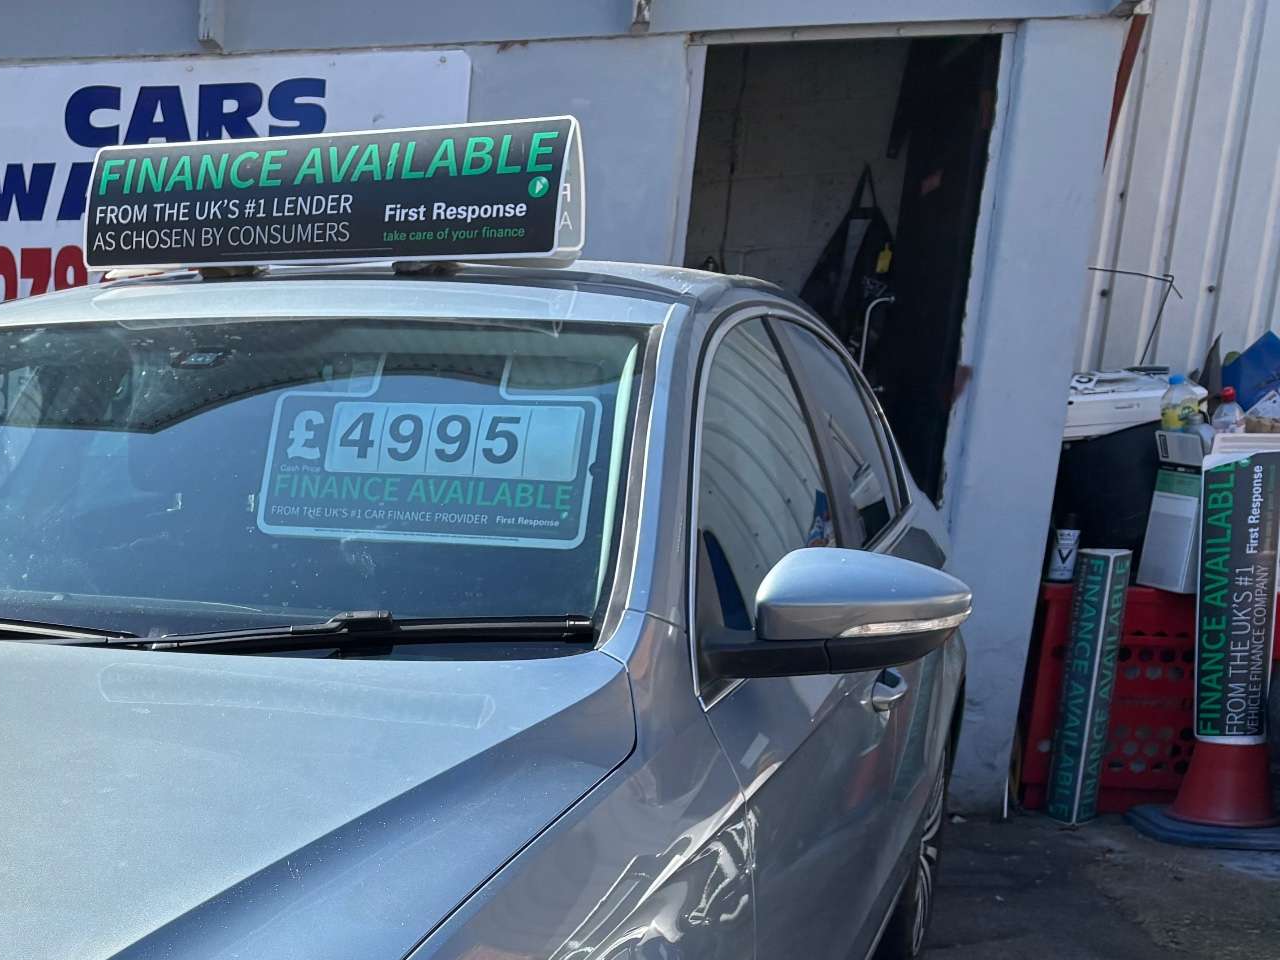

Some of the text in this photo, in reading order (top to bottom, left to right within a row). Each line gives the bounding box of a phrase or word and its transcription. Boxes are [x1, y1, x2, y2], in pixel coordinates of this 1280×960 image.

[65, 78, 327, 147] CARS
[98, 131, 559, 195] FINANCE AVAILABLE
[96, 204, 147, 225] FROM
[153, 203, 190, 222] THE
[245, 199, 266, 218] #1
[272, 194, 353, 217] LENDER
[384, 202, 527, 223] First Response
[93, 222, 350, 250] AS CHOSEN BY CONSUMERS
[383, 226, 524, 242] take care of your finance
[271, 505, 299, 515] FROM
[303, 506, 321, 517] THE
[365, 509, 385, 520] CAR
[387, 510, 431, 522] FINANCE
[434, 512, 488, 525] PROVIDER
[274, 474, 573, 511] FINANCE AVAILABLE
[1246, 465, 1264, 554] First Response
[496, 516, 559, 528] First Response
[1235, 564, 1255, 586] #1
[1253, 565, 1270, 626] COMPANY
[1072, 559, 1105, 674] FINANCE
[1200, 616, 1227, 735] FINANCE
[1229, 639, 1250, 678] THE
[1250, 627, 1265, 681] FINANCE
[1226, 683, 1247, 735] FROM
[1246, 683, 1262, 734] VEHICLE
